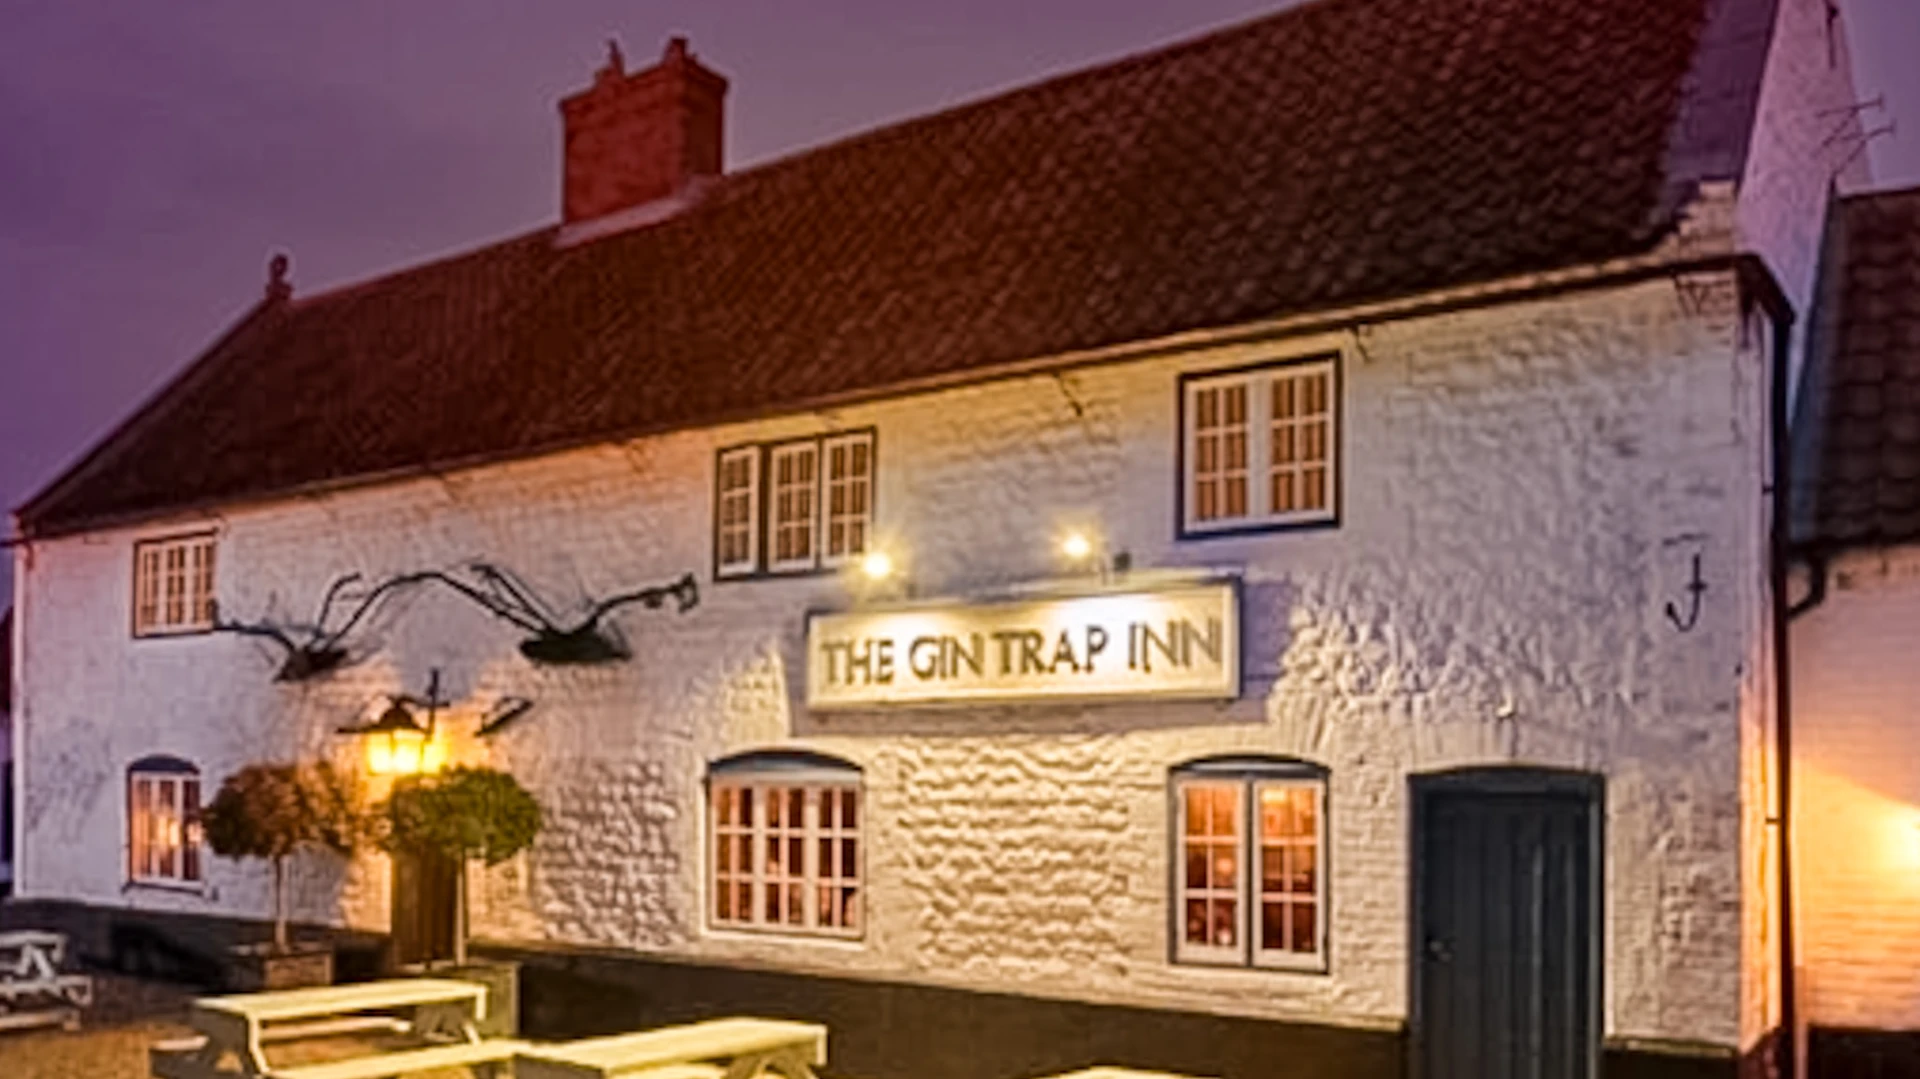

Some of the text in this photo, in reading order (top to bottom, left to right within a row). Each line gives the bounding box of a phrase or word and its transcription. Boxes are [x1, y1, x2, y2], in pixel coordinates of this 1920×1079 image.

[820, 617, 1222, 685] THE GIN TRAP INN
